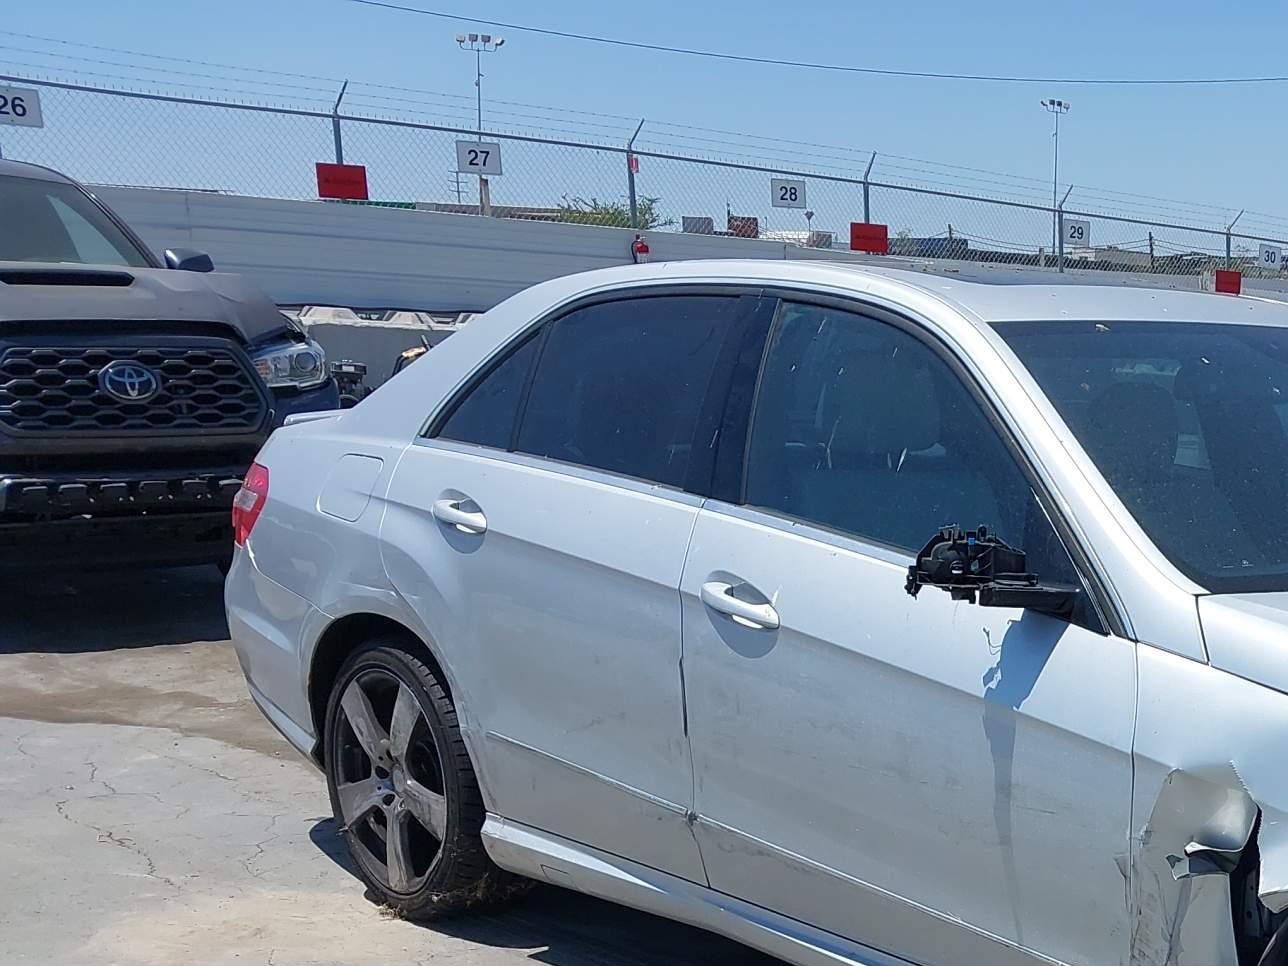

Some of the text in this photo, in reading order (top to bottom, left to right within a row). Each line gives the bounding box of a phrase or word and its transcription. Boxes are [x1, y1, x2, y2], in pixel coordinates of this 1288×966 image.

[0, 94, 27, 117] 26
[467, 149, 490, 167] 27
[779, 185, 798, 202] 28
[1069, 225, 1084, 240] 29
[1264, 250, 1276, 264] 30
